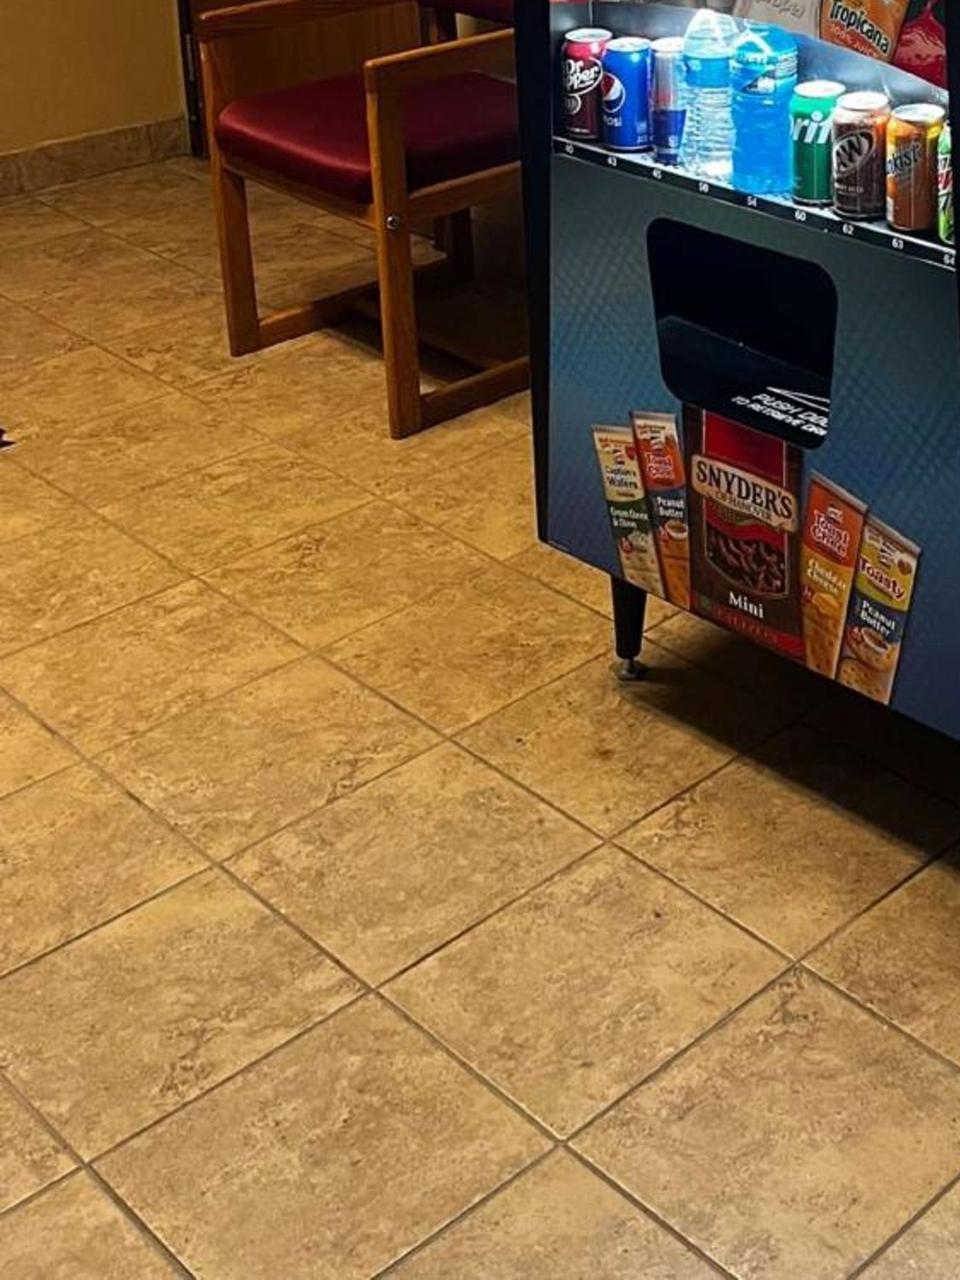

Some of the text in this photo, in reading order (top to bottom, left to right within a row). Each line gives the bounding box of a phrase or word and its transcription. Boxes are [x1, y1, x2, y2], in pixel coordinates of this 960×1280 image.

[887, 143, 920, 172] kist
[794, 210, 806, 221] 60
[842, 224, 854, 235] 62
[892, 237, 904, 249] 63
[696, 460, 793, 520] SNYDER'S
[860, 556, 906, 602] Toasty
[728, 591, 764, 619] Mini
[862, 600, 896, 631] Peanut
[860, 610, 891, 637] Butter
